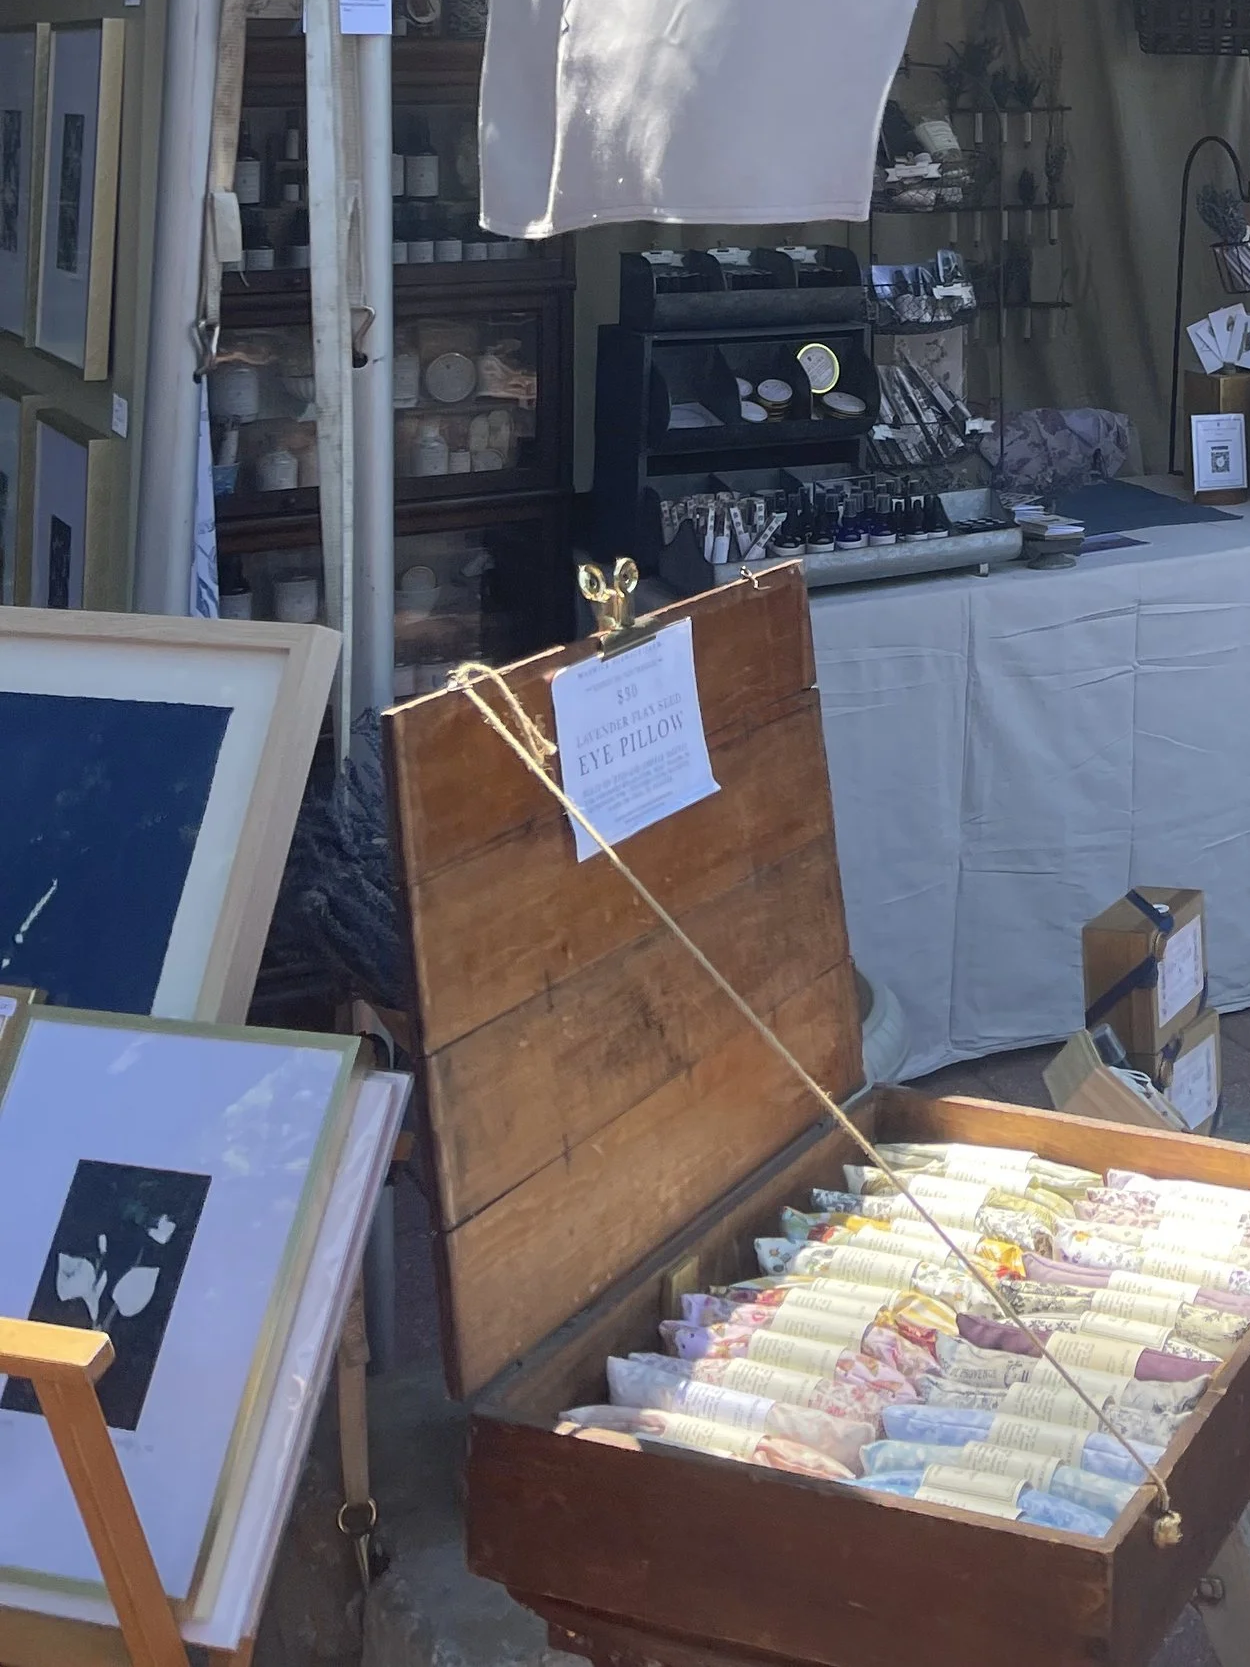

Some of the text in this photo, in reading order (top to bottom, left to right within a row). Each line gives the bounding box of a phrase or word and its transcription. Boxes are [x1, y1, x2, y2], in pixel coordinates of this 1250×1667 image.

[576, 716, 629, 749] LAVENDER
[657, 692, 682, 711] SEED
[579, 710, 684, 776] EYE PILLOW
